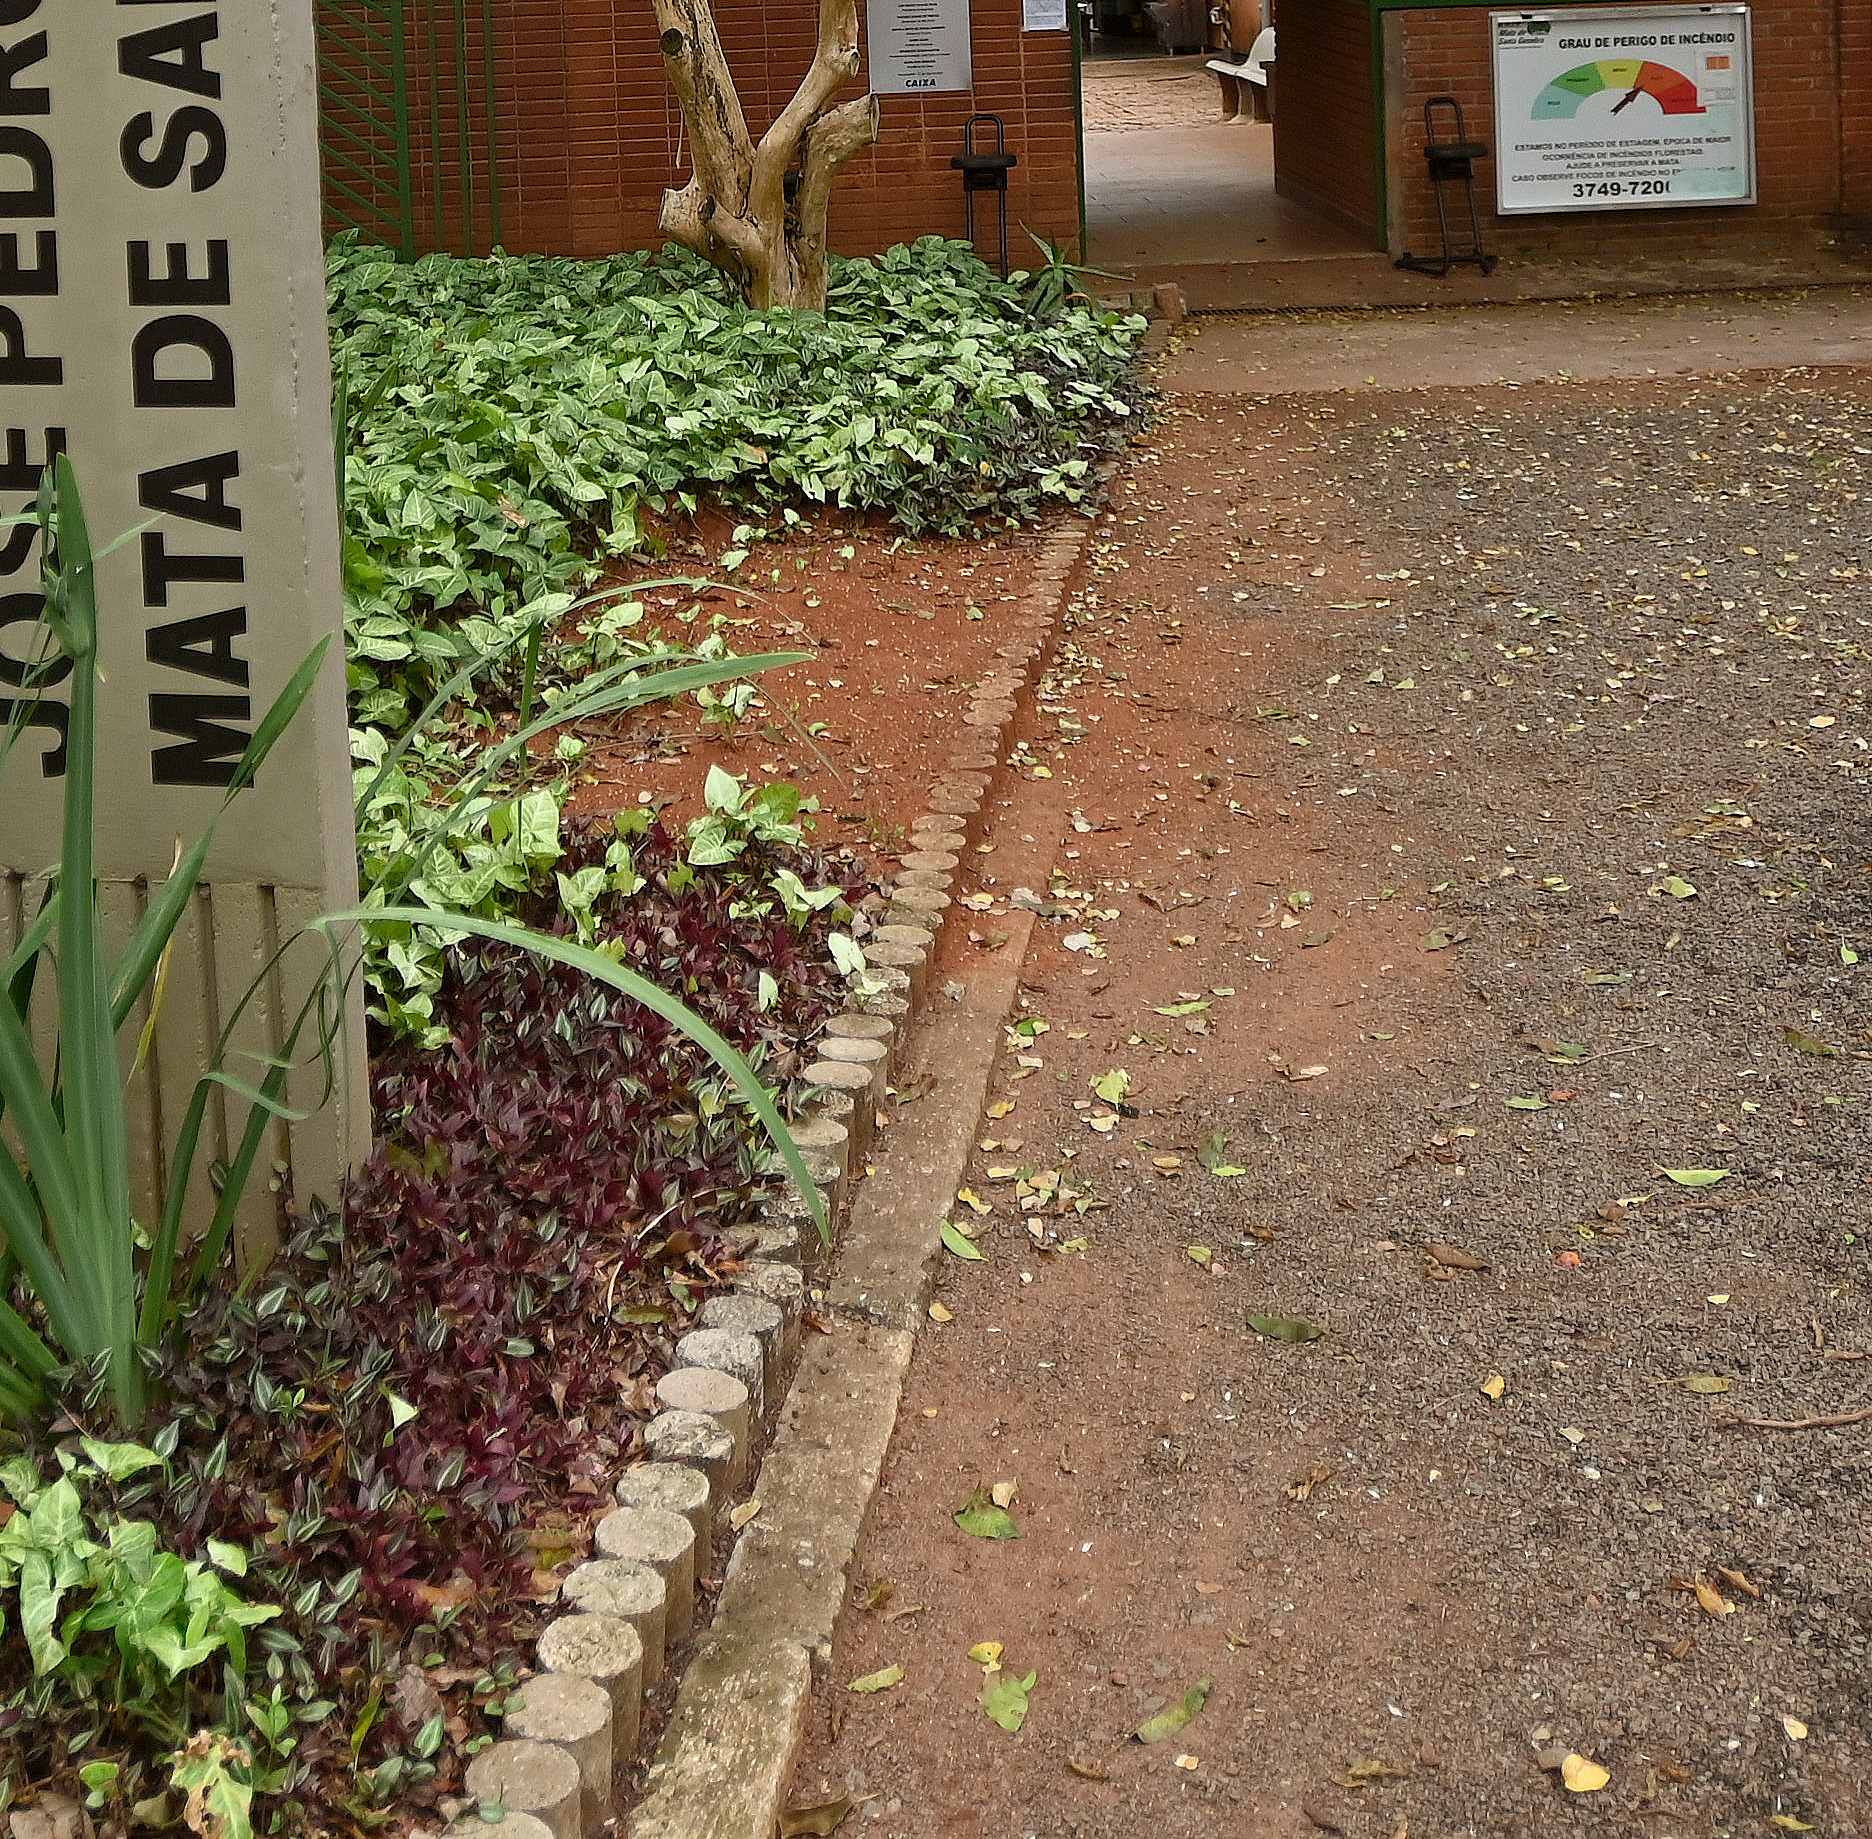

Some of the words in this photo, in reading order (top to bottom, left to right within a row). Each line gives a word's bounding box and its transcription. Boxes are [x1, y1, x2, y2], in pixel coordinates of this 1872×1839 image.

[1559, 38, 1591, 49] GRAU
[1595, 37, 1610, 47] DE
[1613, 35, 1656, 47] PERIGO
[1660, 34, 1675, 45] DE
[1679, 31, 1735, 45] INCÊNDIO
[905, 79, 936, 87] CAIXA
[1515, 142, 1552, 151] ESTAMOS
[1555, 141, 1566, 149] NO
[1606, 139, 1617, 147] DE
[1693, 136, 1703, 144] DE
[1597, 150, 1608, 159] DE
[1566, 160, 1593, 169] AJUDE
[1512, 173, 1534, 182] CASO
[1576, 170, 1603, 180] FOCOS
[1606, 169, 1617, 178] DE
[128, 238, 235, 408] DE
[137, 449, 255, 789] MATA
